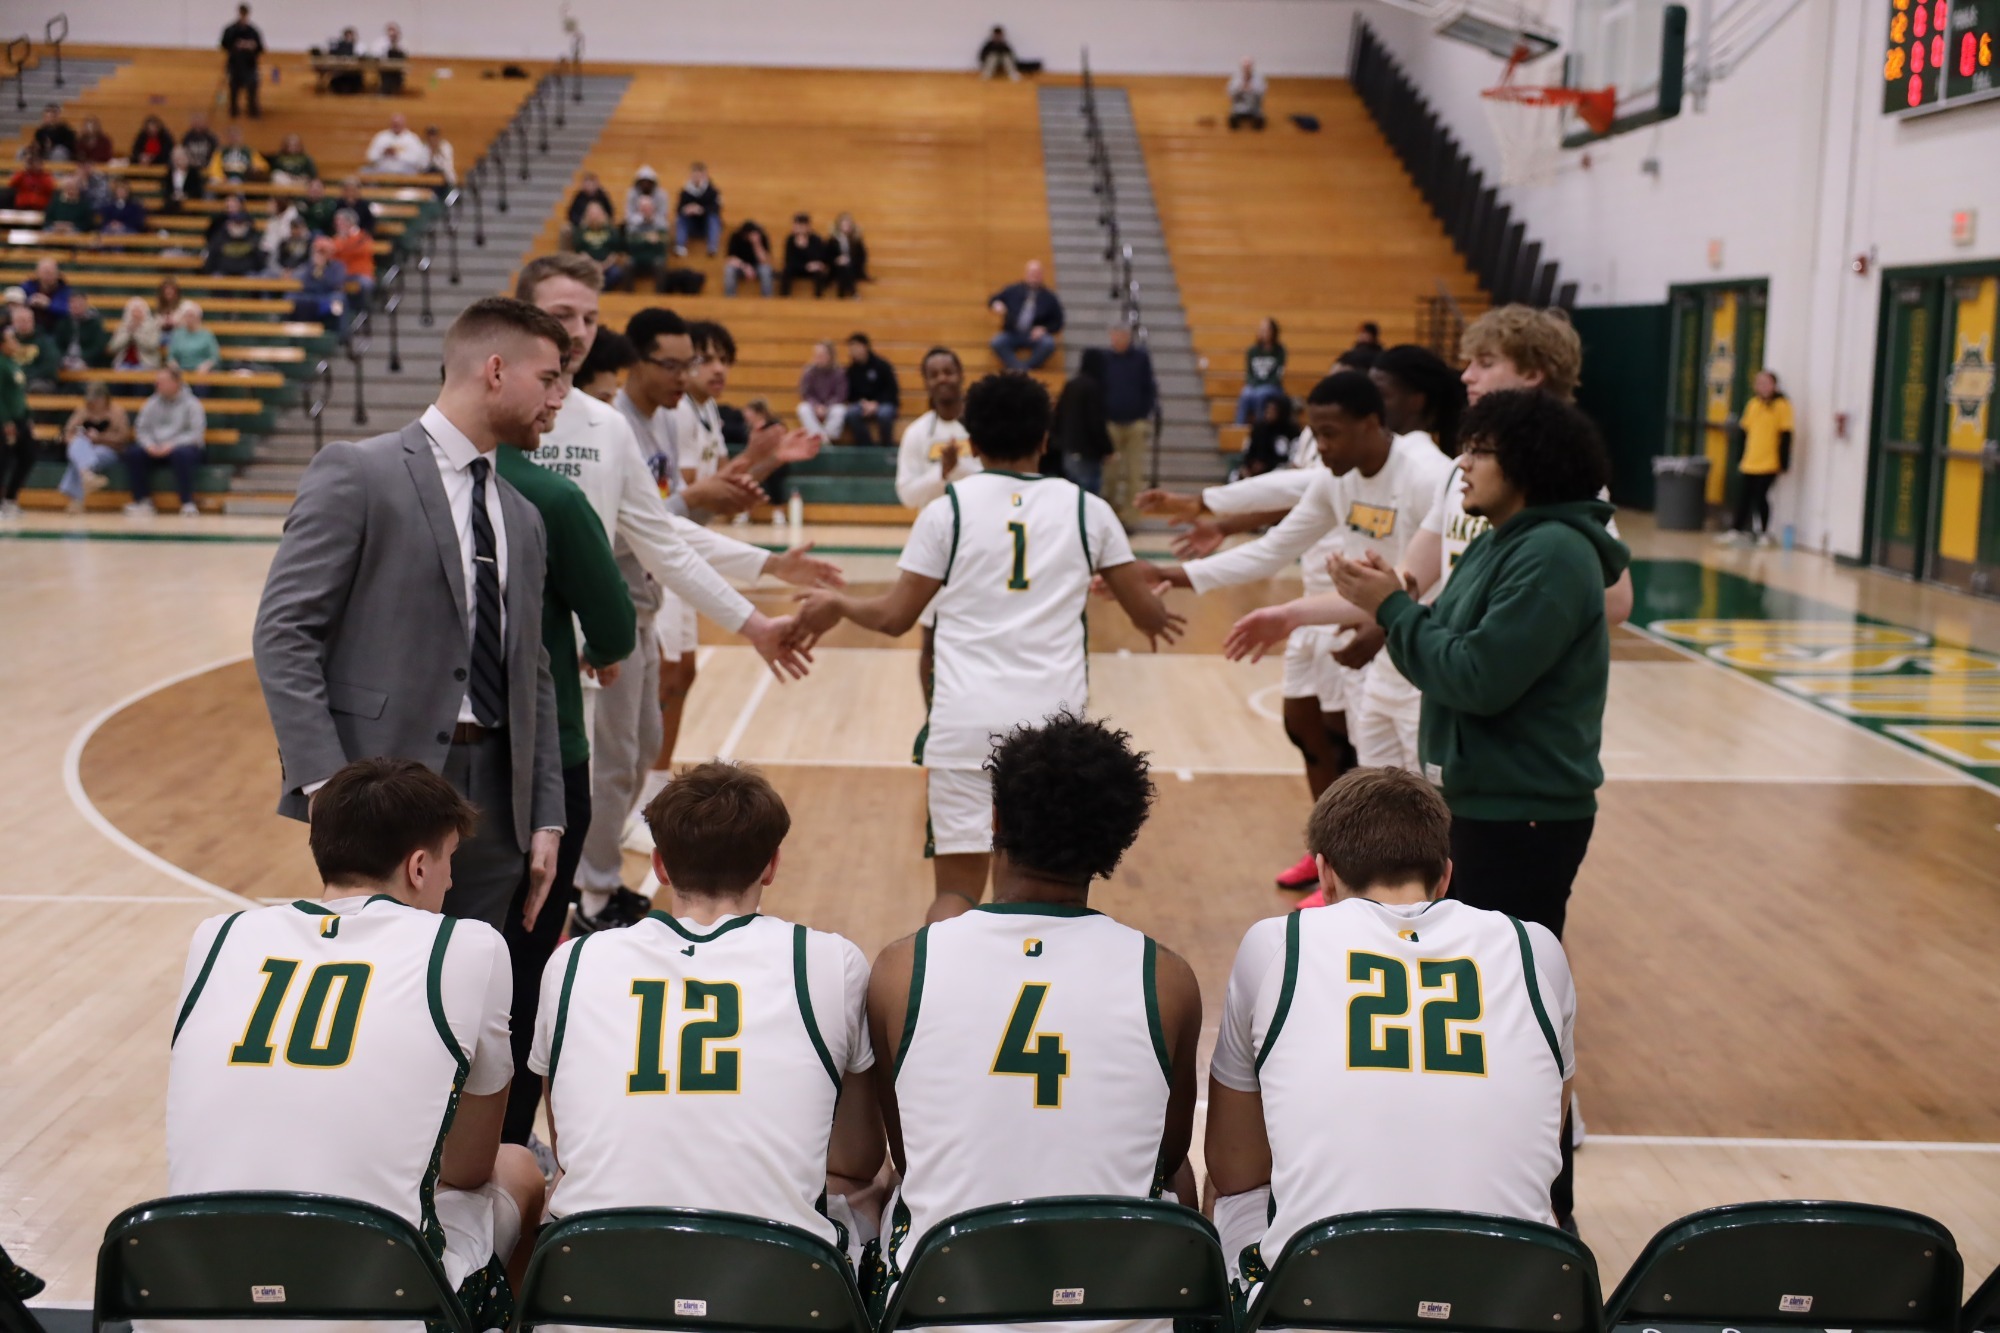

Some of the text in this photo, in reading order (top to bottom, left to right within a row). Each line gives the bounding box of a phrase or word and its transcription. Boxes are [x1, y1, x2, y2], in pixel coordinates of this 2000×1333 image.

[565, 446, 600, 462] STATE
[1006, 520, 1031, 591] 1
[227, 955, 374, 1069] 10
[626, 977, 742, 1095] 12
[988, 981, 1071, 1109] 4
[1345, 949, 1489, 1078] 22
